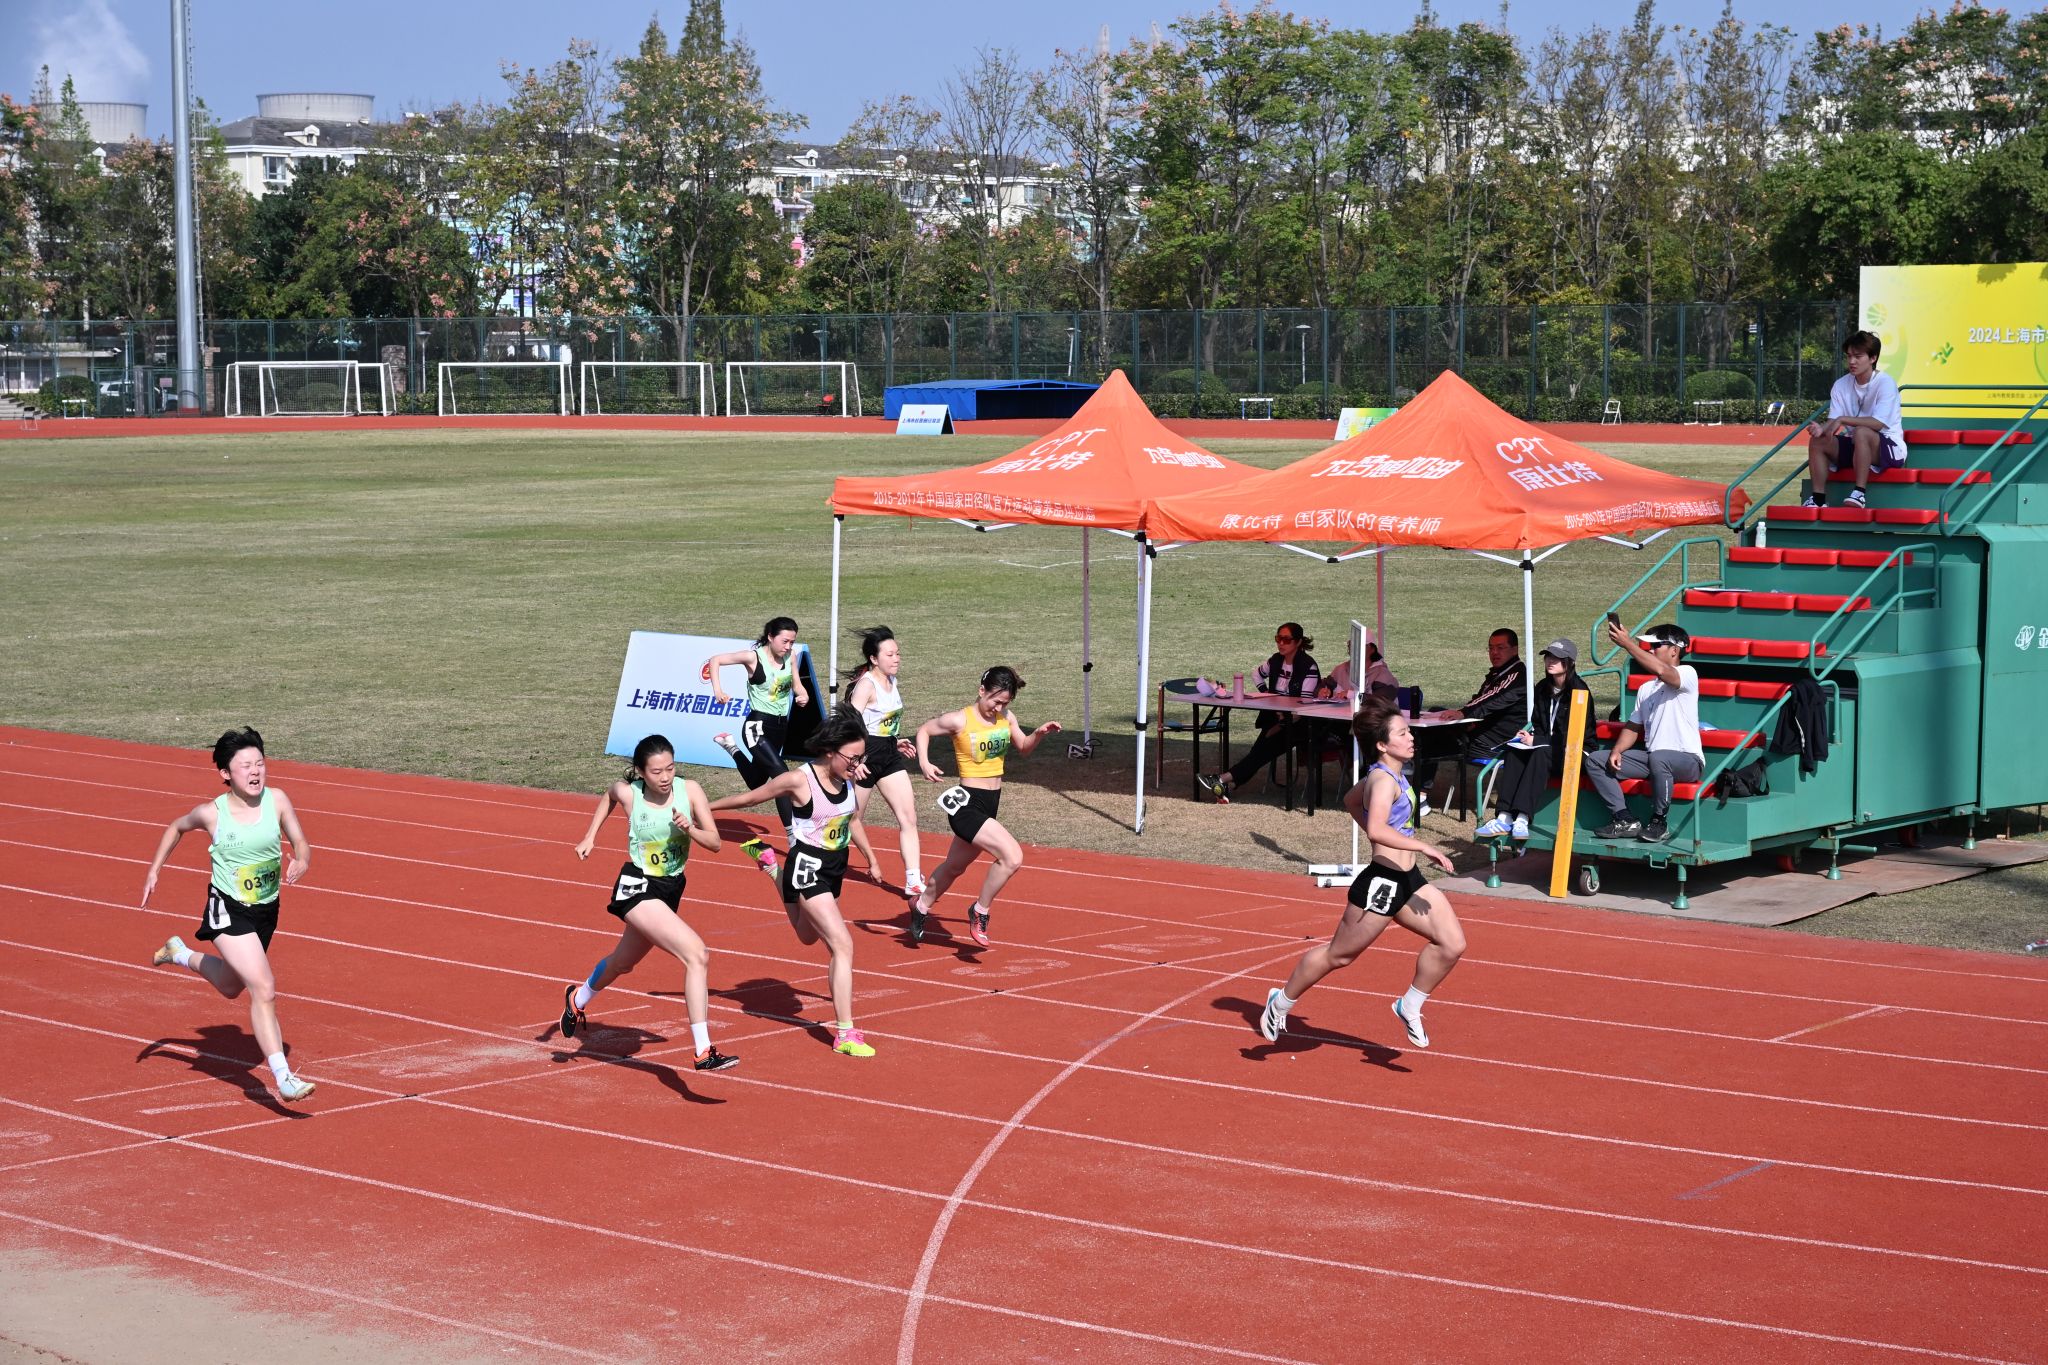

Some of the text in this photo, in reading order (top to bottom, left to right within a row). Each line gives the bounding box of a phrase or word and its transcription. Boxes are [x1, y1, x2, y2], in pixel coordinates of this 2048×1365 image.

[1968, 327, 2048, 344] 2024上海市
[1029, 428, 1106, 456] CPT
[1495, 436, 1554, 464] CPT
[976, 451, 1094, 474] 康比特
[1310, 454, 1464, 479] 为梦想加油
[1507, 460, 1605, 492] 康比特
[1219, 508, 1444, 536] 康比特 国家队的营养师
[243, 870, 276, 891] 0379
[796, 857, 817, 887] 5
[1370, 881, 1393, 911] 4
